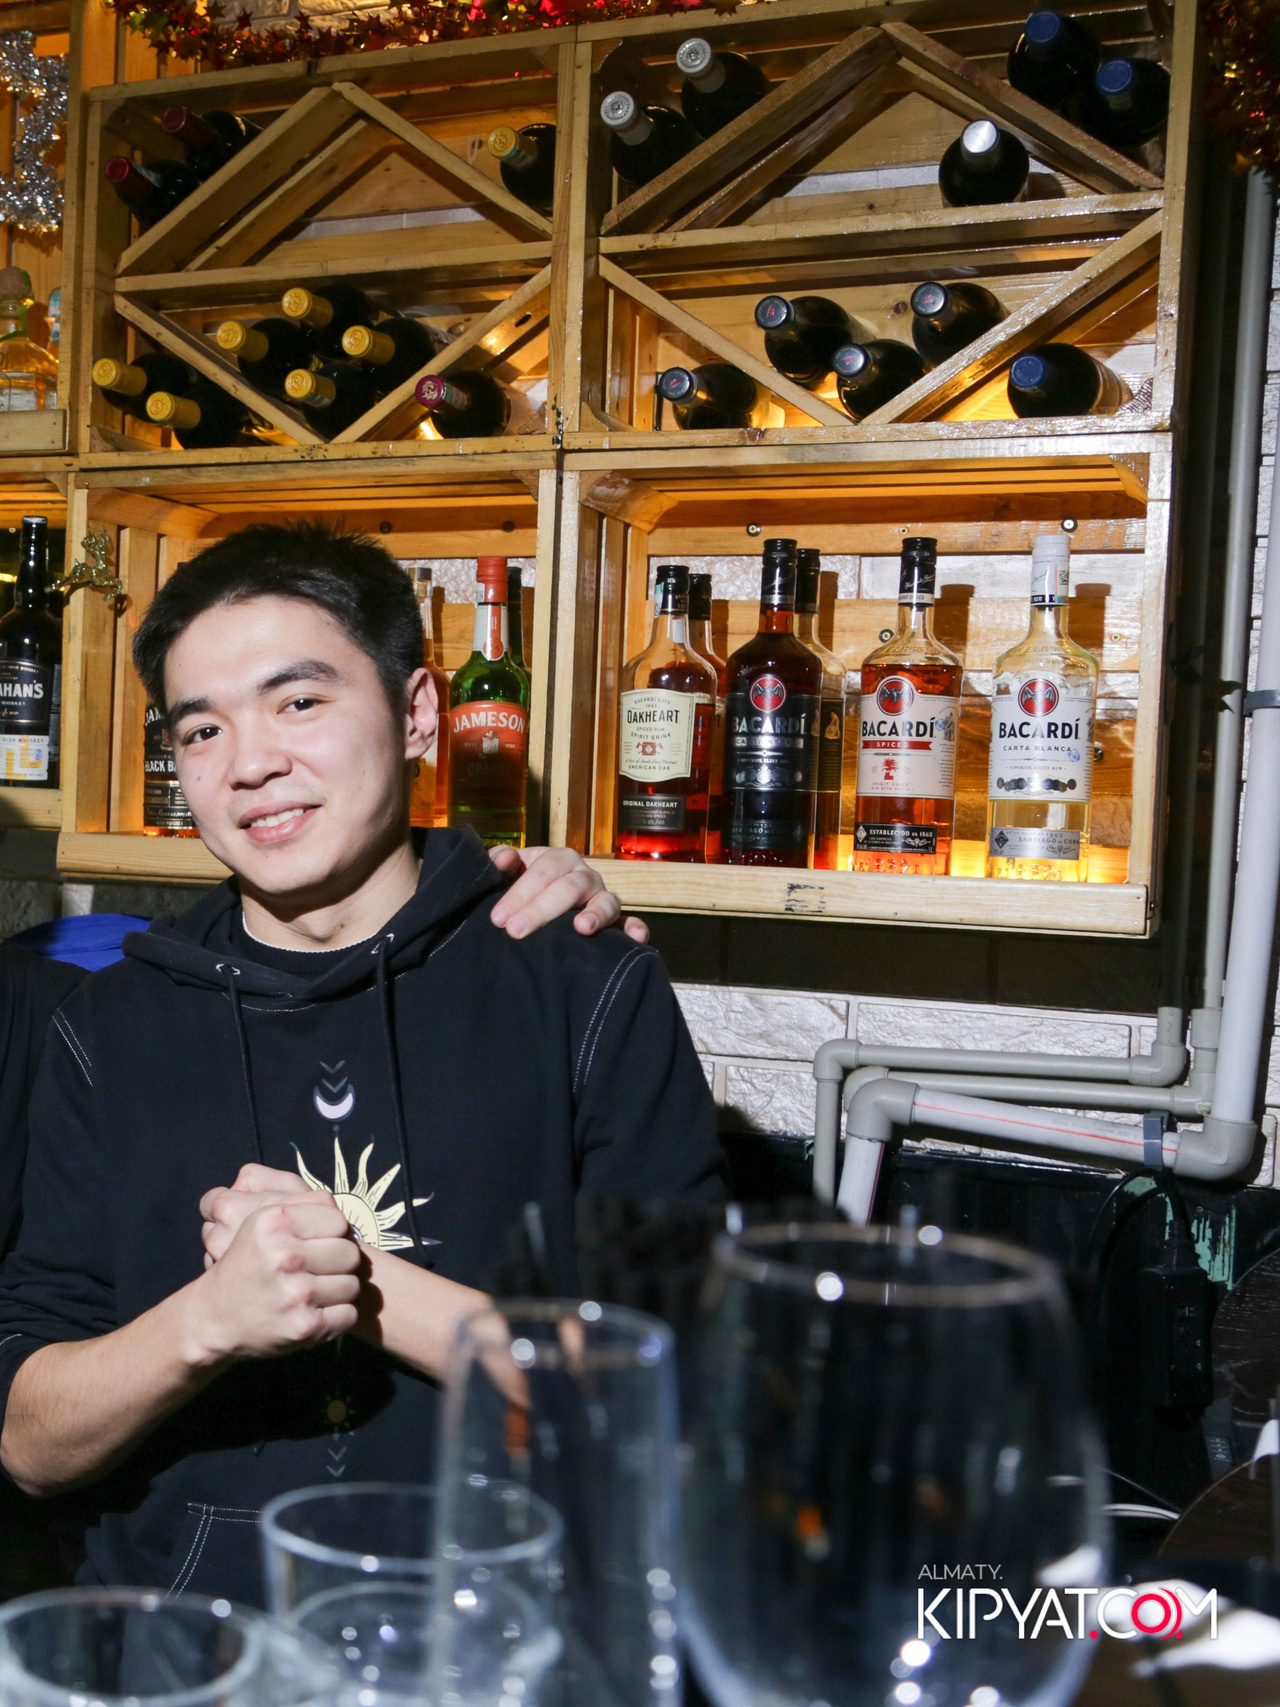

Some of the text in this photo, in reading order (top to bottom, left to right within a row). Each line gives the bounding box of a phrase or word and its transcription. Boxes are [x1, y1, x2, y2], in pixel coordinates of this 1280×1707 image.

[453, 711, 526, 734] JAMESON
[627, 709, 680, 724] OAKHEART
[731, 713, 806, 734] BACARDÍ
[862, 716, 936, 738] BACARDÍ
[999, 717, 1081, 740] BACARDÍ
[145, 760, 165, 772] BLACK
[645, 801, 678, 809] OAKHEART
